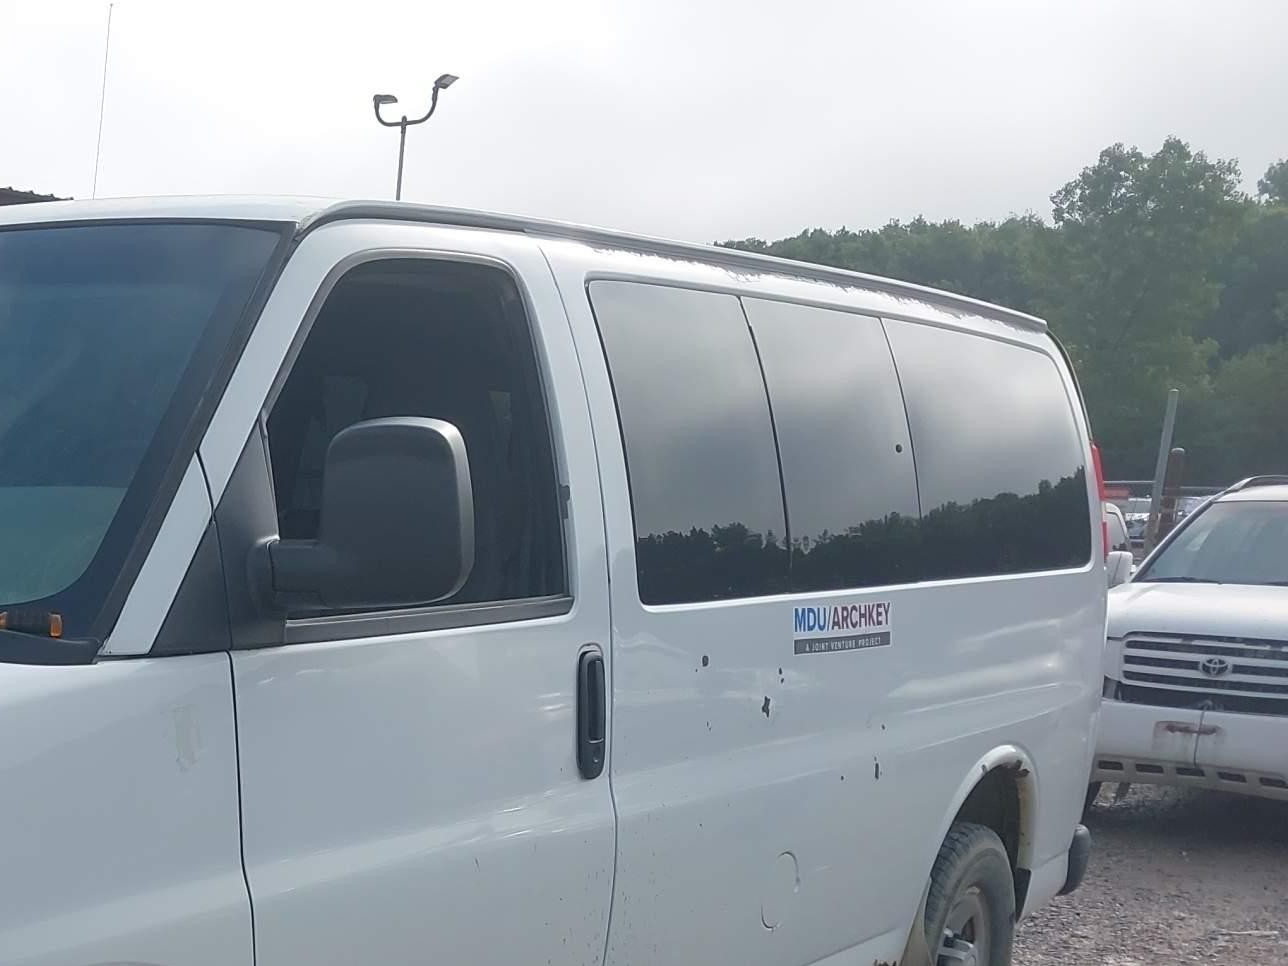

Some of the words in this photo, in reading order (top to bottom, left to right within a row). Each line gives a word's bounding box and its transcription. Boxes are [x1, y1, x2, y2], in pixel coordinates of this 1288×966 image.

[794, 602, 890, 633] MDU/ARCHKEY
[812, 642, 829, 652] JOINT
[831, 639, 856, 650] VENTURE
[858, 636, 881, 648] PROJECT
